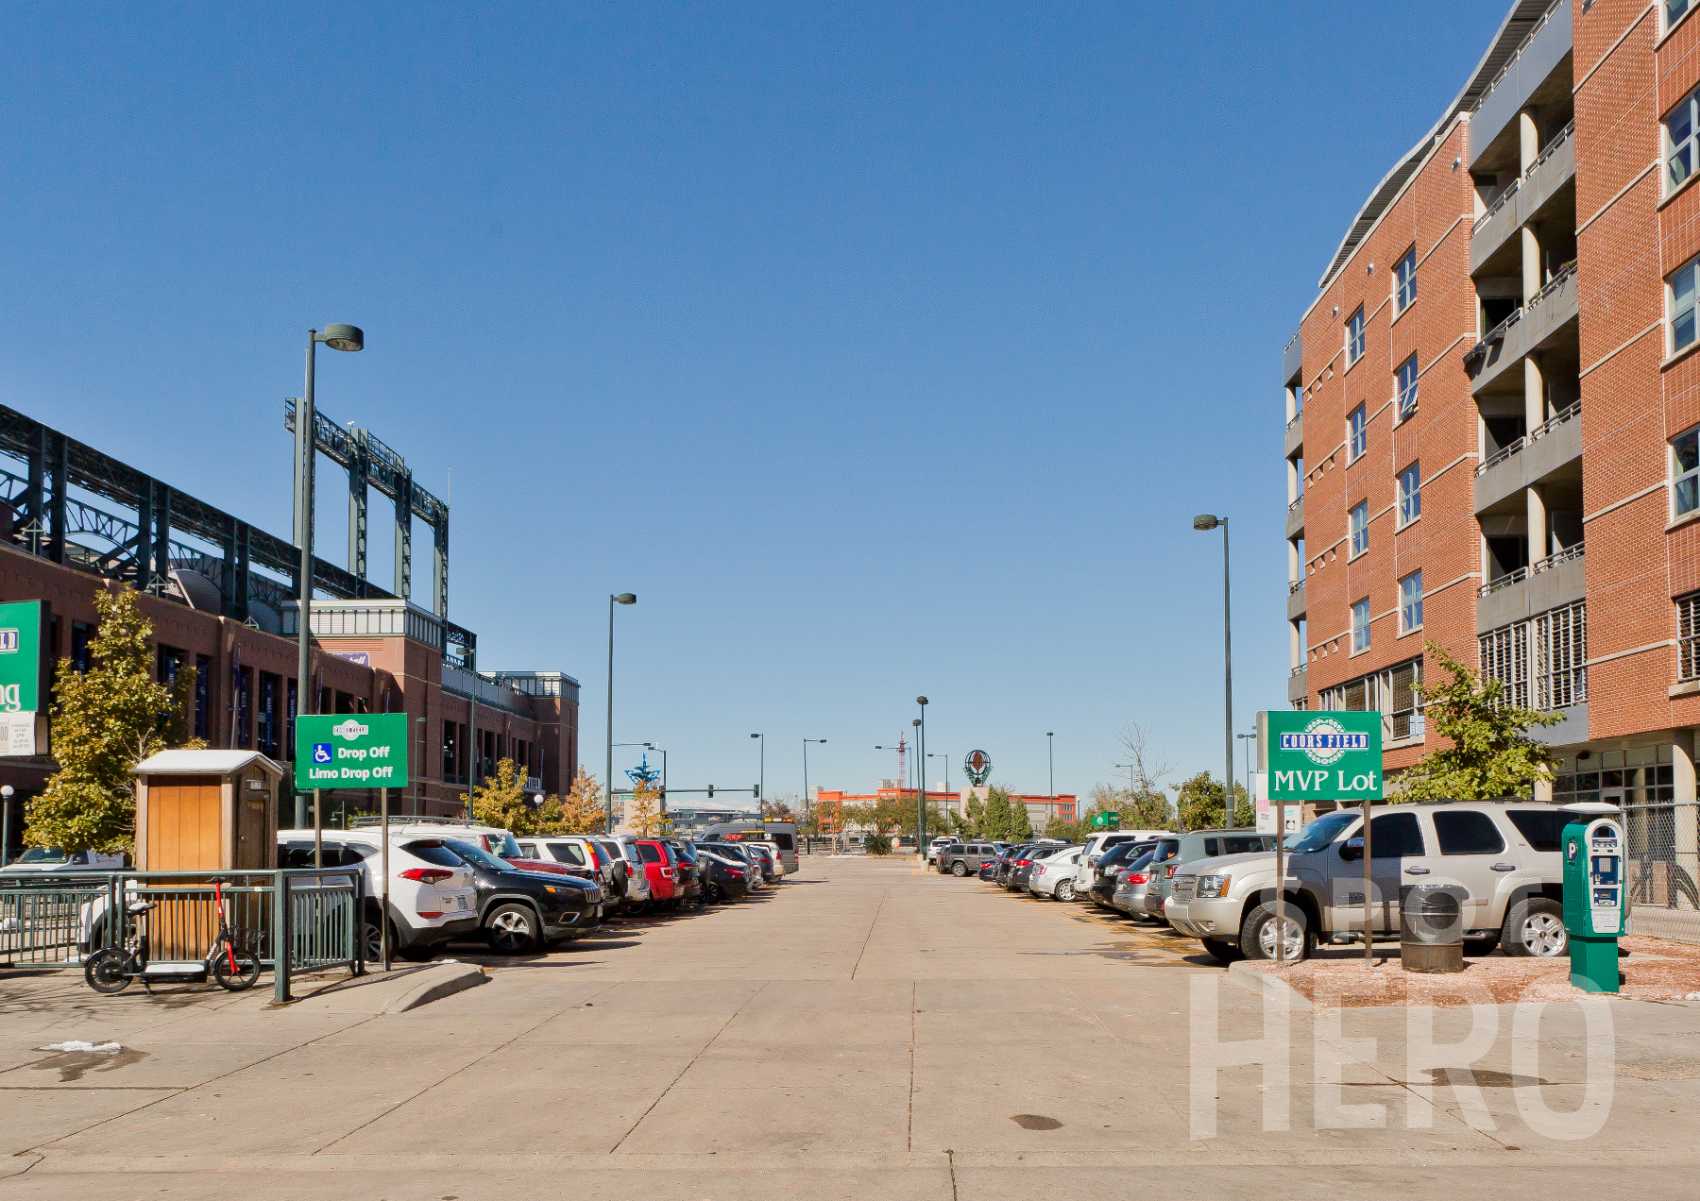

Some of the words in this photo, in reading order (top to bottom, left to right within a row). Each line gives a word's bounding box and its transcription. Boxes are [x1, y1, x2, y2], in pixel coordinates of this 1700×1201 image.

[1283, 734, 1323, 749] COORS
[1328, 734, 1367, 749] FIELD
[338, 747, 367, 762] Drop
[369, 745, 390, 758] Off
[309, 768, 338, 779] Limo
[341, 767, 369, 781] Drop
[372, 766, 393, 778] Off
[1274, 769, 1329, 791] MVP
[1337, 769, 1378, 791] Lot
[1568, 842, 1576, 859] P
